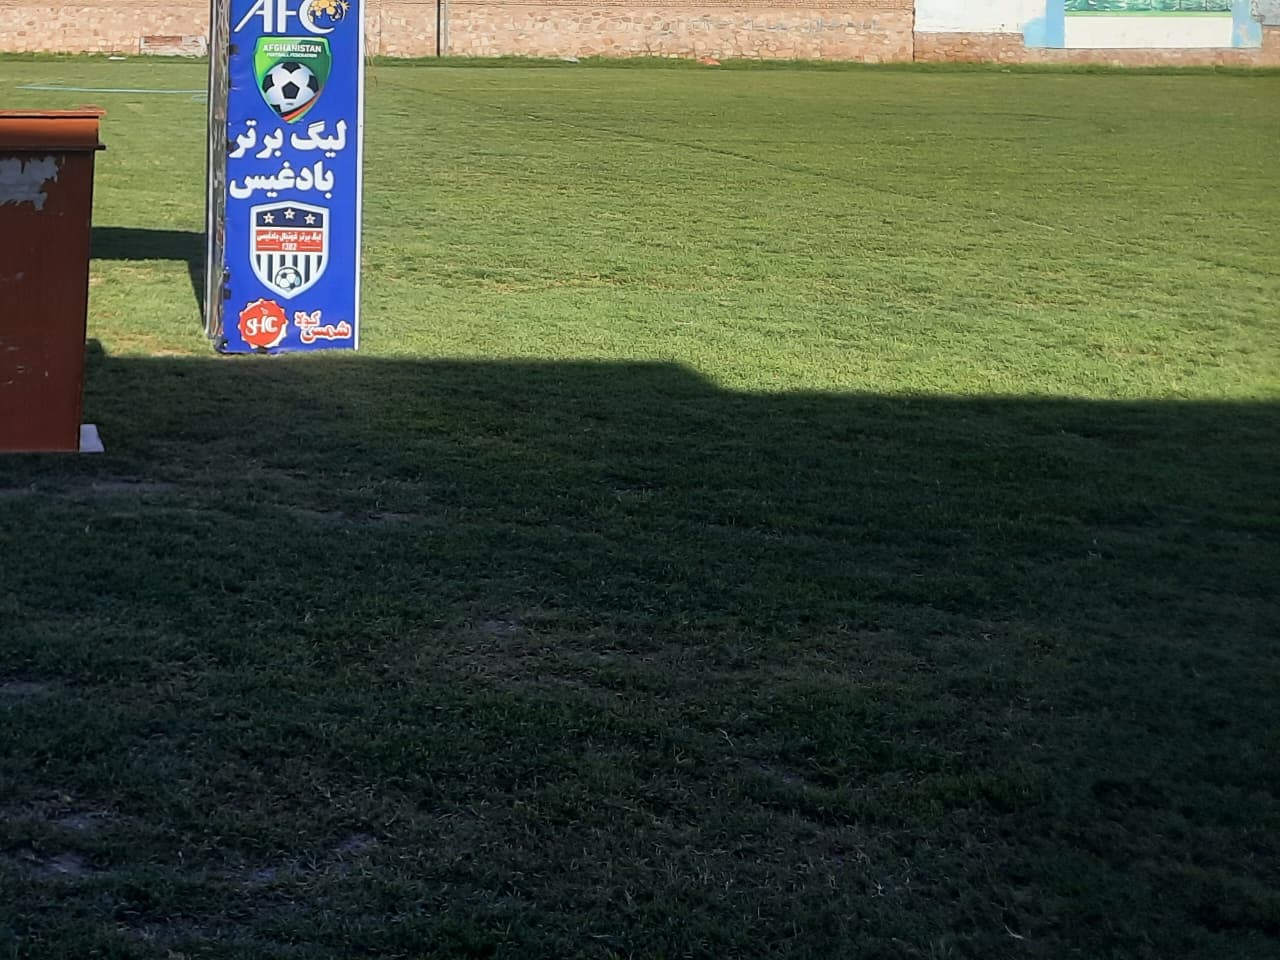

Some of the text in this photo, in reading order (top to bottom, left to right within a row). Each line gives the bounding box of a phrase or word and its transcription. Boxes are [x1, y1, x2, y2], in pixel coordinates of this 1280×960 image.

[263, 44, 322, 53] AFGHANISTAN
[228, 120, 348, 159] لیگ برتر
[229, 161, 335, 200] بادغیس
